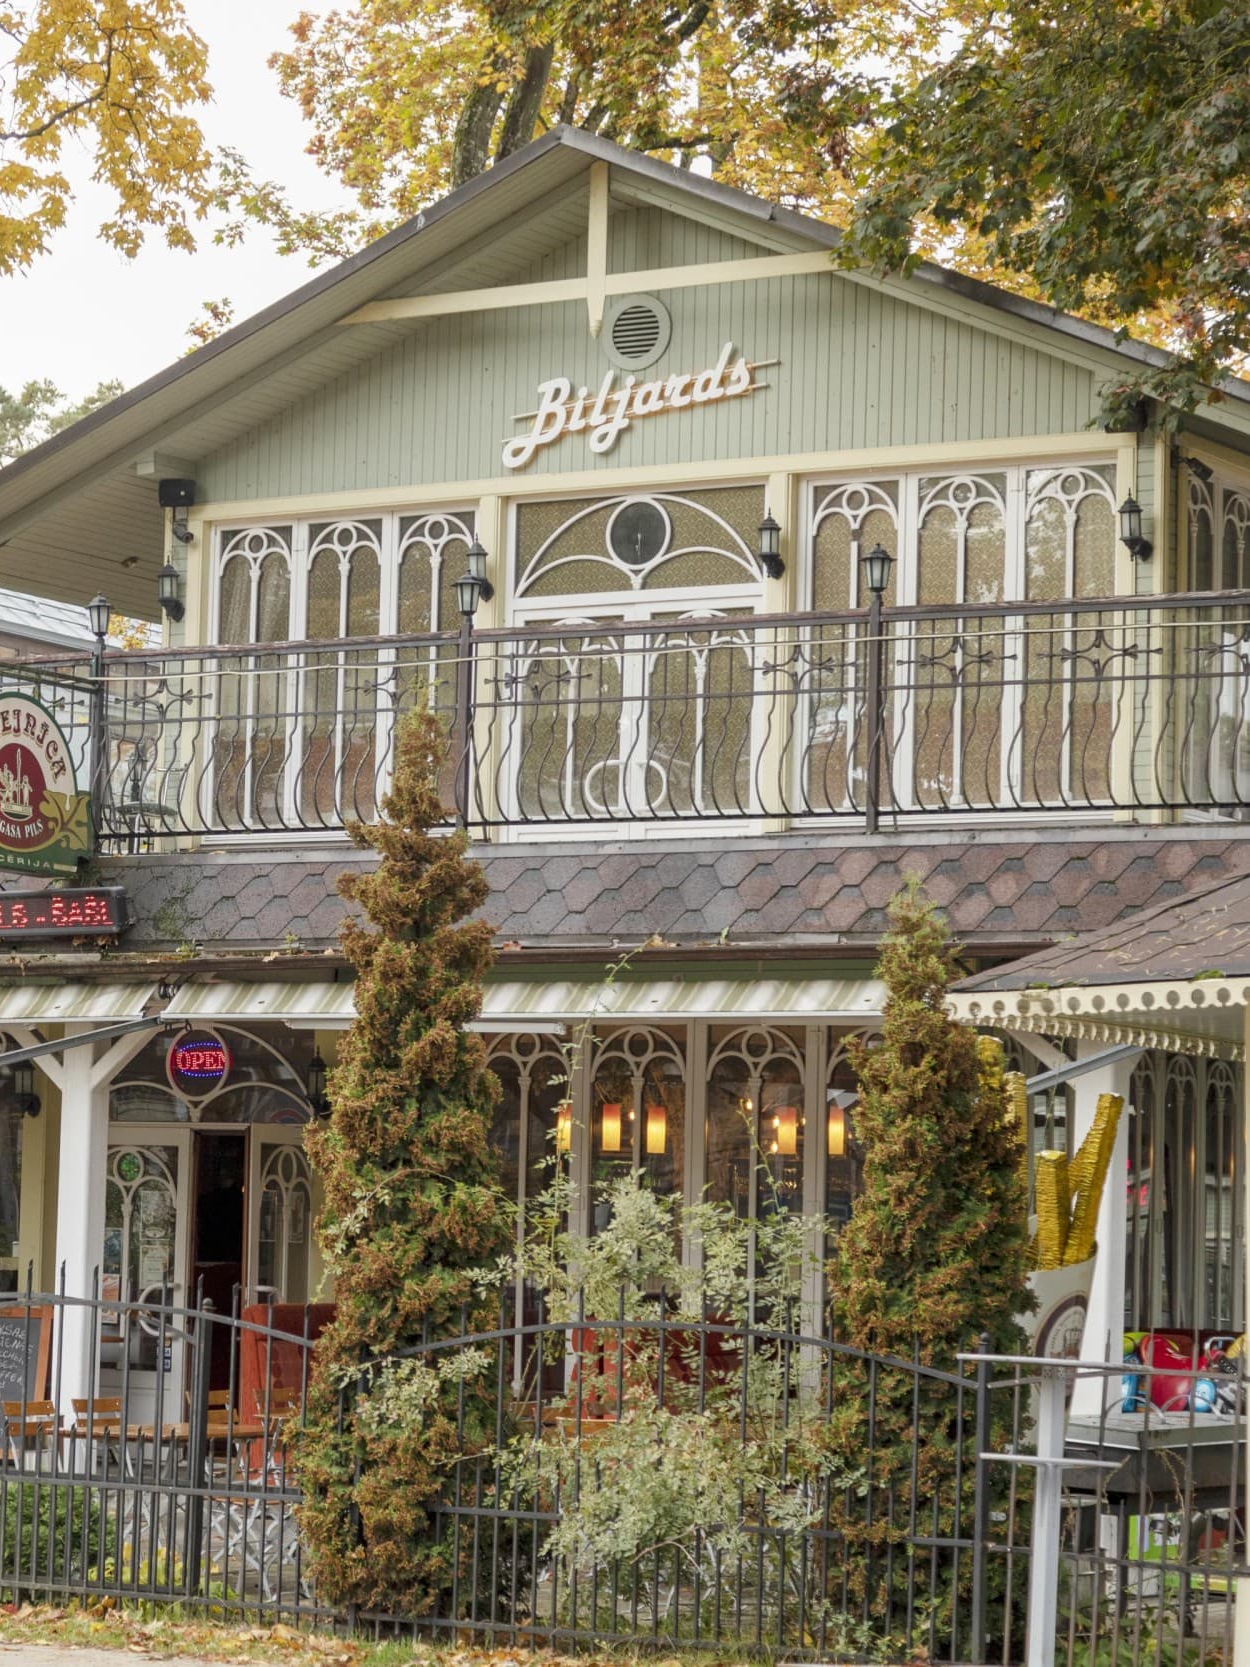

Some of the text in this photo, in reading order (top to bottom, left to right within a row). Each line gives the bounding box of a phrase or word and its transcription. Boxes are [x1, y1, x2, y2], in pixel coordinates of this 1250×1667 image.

[502, 341, 750, 469] Biljards
[24, 818, 43, 838] PILS
[176, 1051, 226, 1070] OPEN
